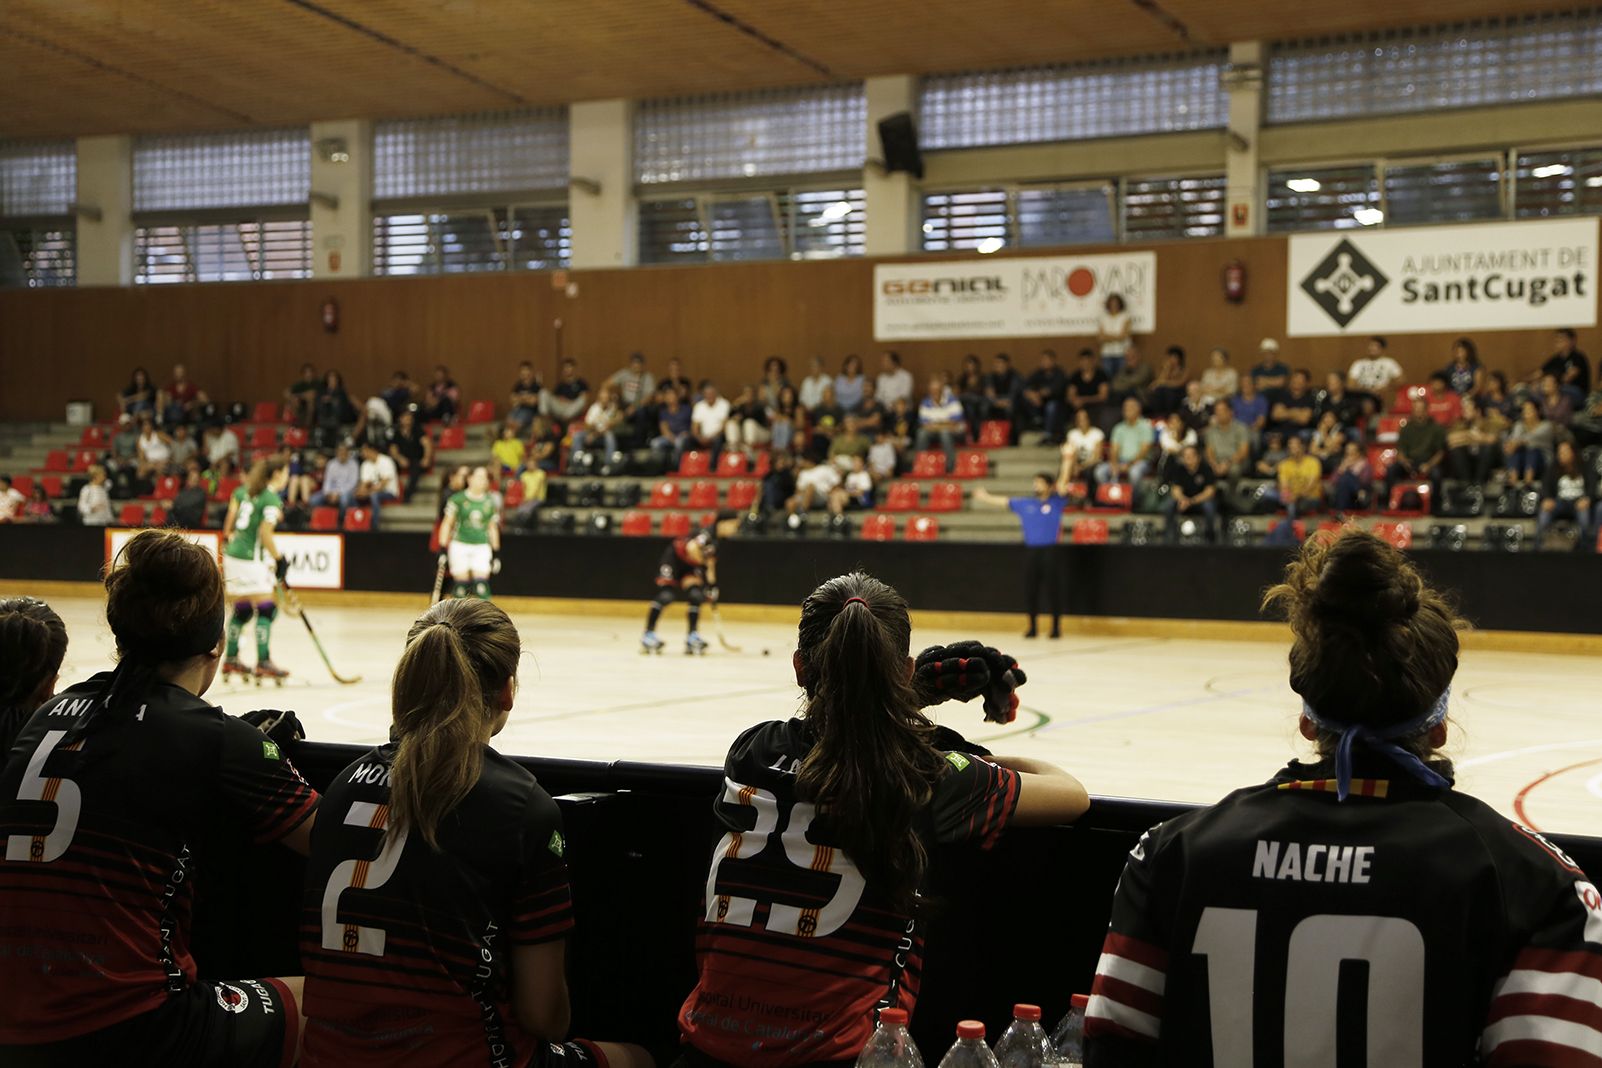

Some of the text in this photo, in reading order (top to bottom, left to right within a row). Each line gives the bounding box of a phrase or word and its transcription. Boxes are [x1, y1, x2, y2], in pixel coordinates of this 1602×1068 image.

[1401, 246, 1588, 274] AJUNTAMENT DE
[1402, 270, 1588, 306] SantCugat
[5, 730, 85, 863] 5
[703, 776, 867, 939] 25
[1252, 839, 1375, 884] NACHE
[321, 801, 410, 957] 2
[1191, 906, 1426, 1068] 10
